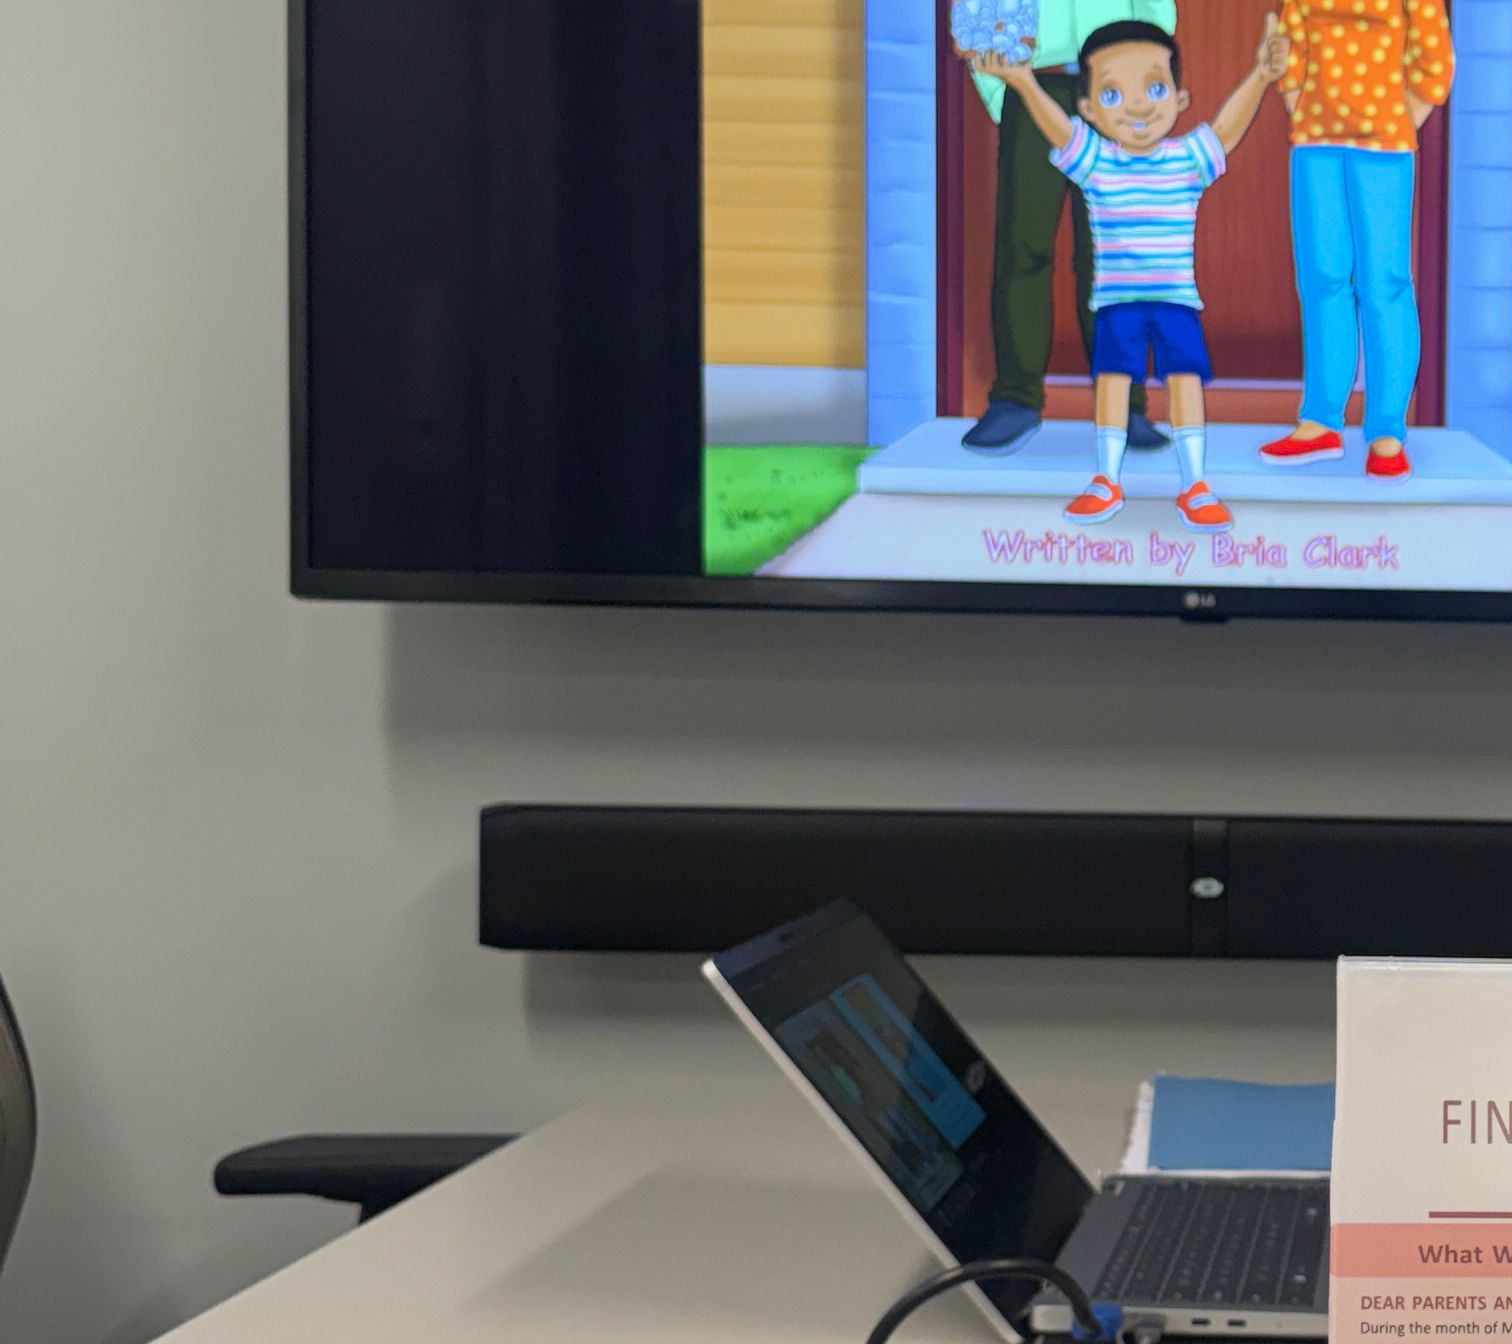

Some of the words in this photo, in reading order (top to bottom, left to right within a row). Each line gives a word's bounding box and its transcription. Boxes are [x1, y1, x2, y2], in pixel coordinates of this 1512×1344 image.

[983, 529, 1134, 567] Written
[1149, 531, 1197, 576] by
[1211, 532, 1288, 569] Bria
[1303, 535, 1401, 570] Clark
[1418, 1244, 1483, 1265] What
[1361, 1296, 1405, 1310] DEAR
[1413, 1296, 1486, 1310] PARENTS
[1360, 1322, 1405, 1337] During
[1409, 1321, 1431, 1334] the
[1436, 1321, 1479, 1334] month
[1484, 1321, 1498, 1334] of
